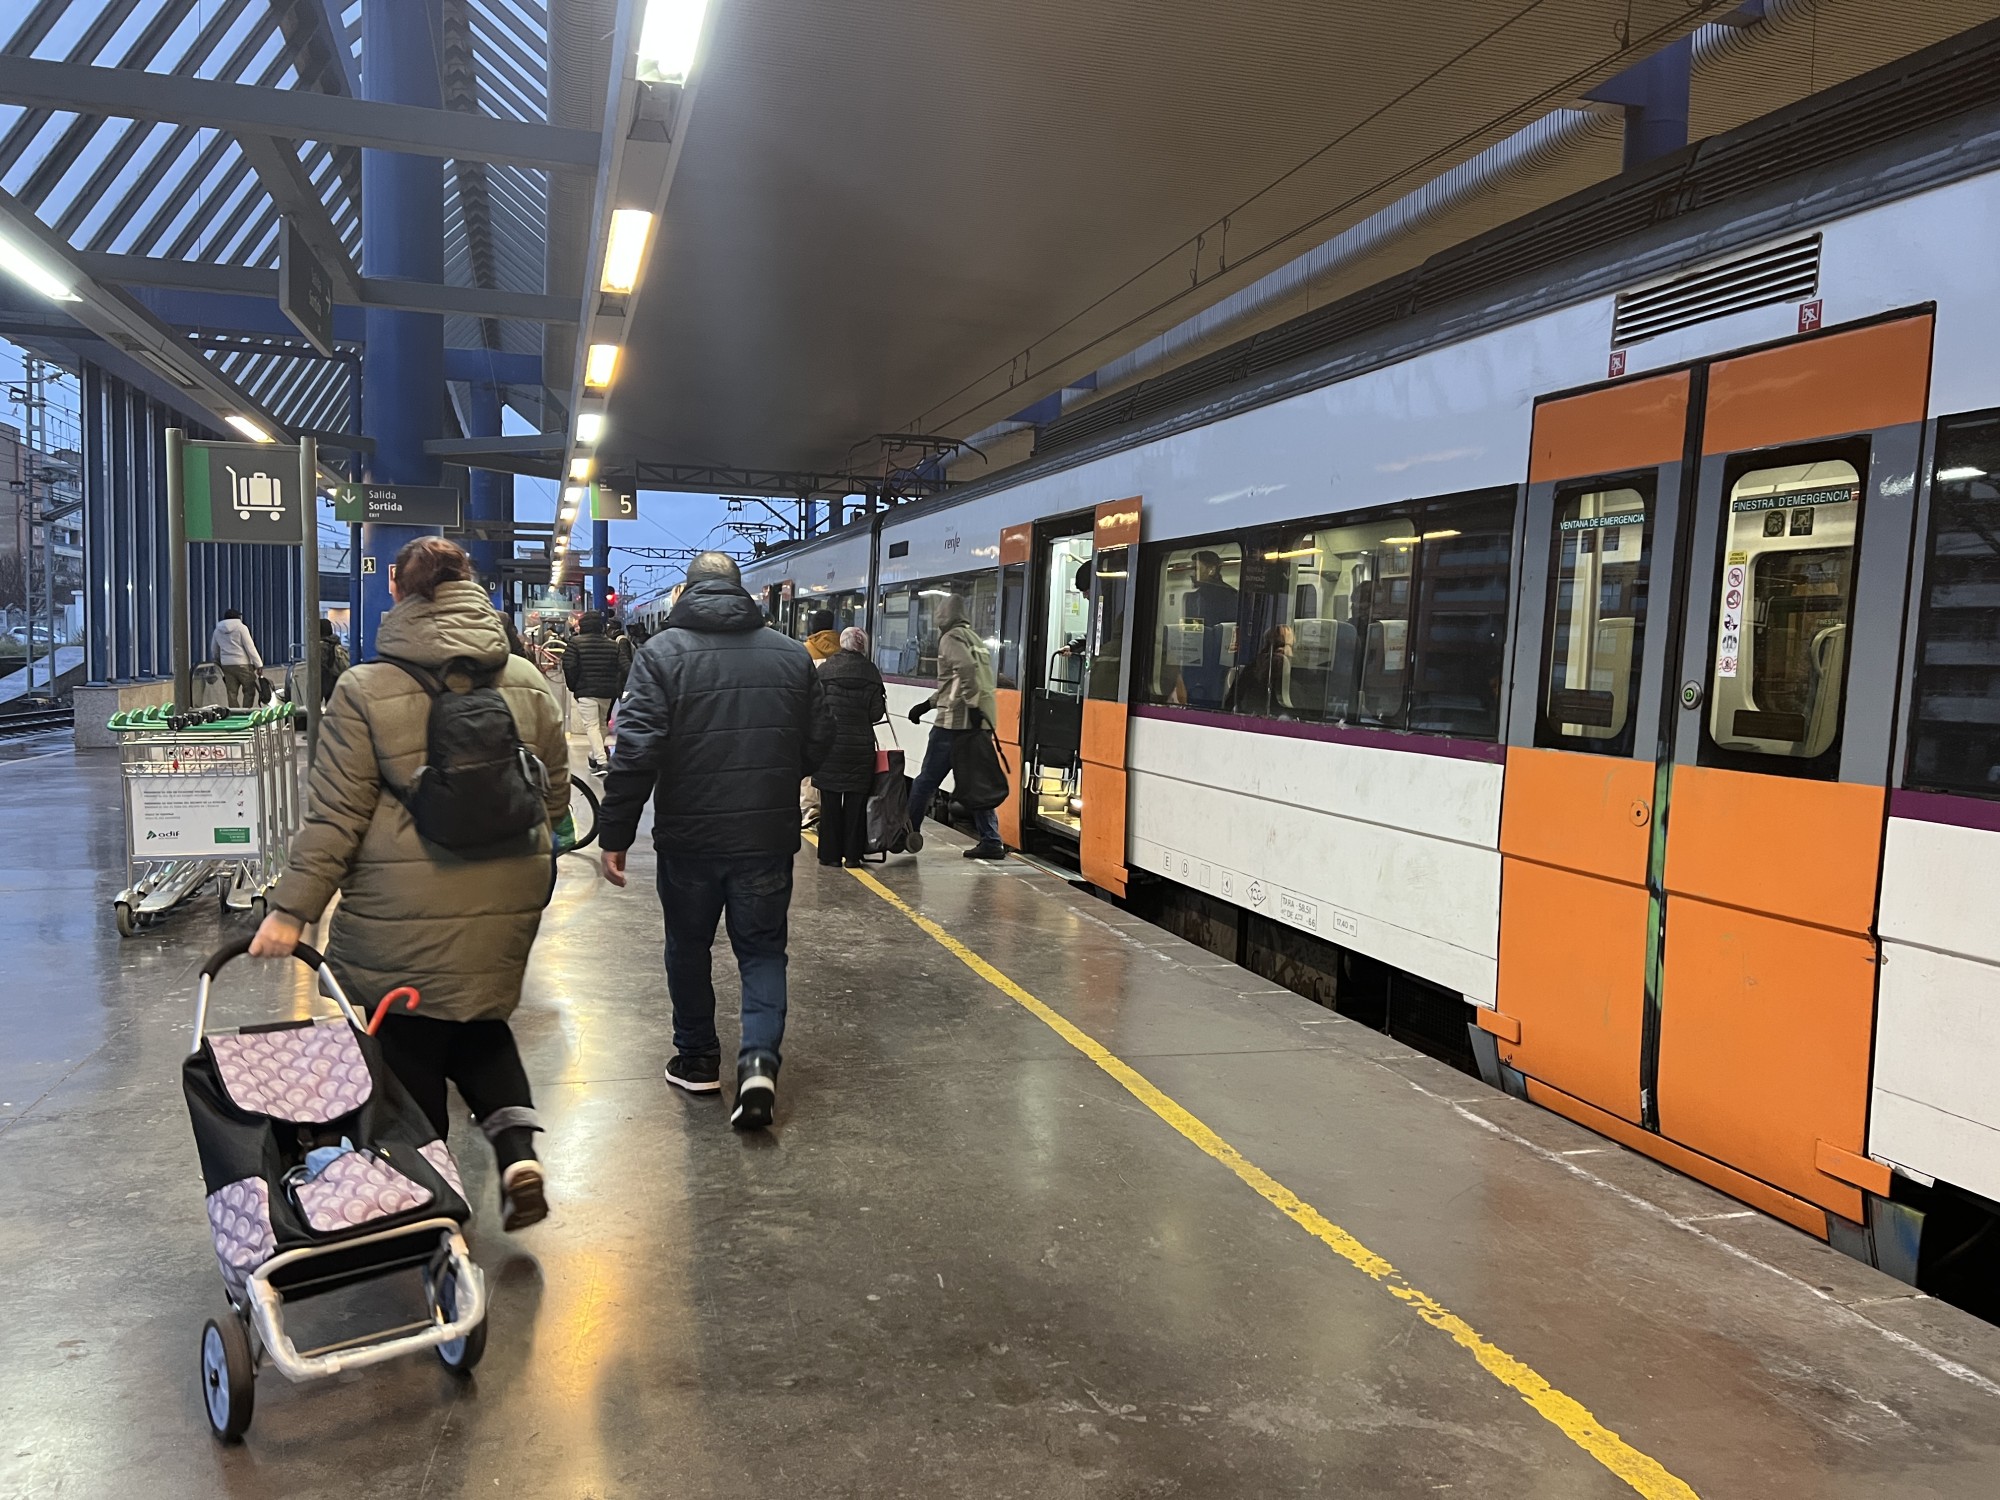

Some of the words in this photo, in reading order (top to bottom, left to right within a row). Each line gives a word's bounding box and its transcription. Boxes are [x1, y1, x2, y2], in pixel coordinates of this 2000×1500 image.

[369, 490, 397, 500] Salida
[369, 502, 403, 512] Sortida
[620, 494, 632, 514] 5
[1733, 498, 1775, 511] FINESTRA
[1560, 519, 1589, 531] VENTANA
[1589, 518, 1599, 527] DE
[1600, 513, 1645, 526] EMERGENCIA
[944, 531, 961, 554] renfe
[490, 581, 496, 591] D
[158, 830, 180, 838] adif
